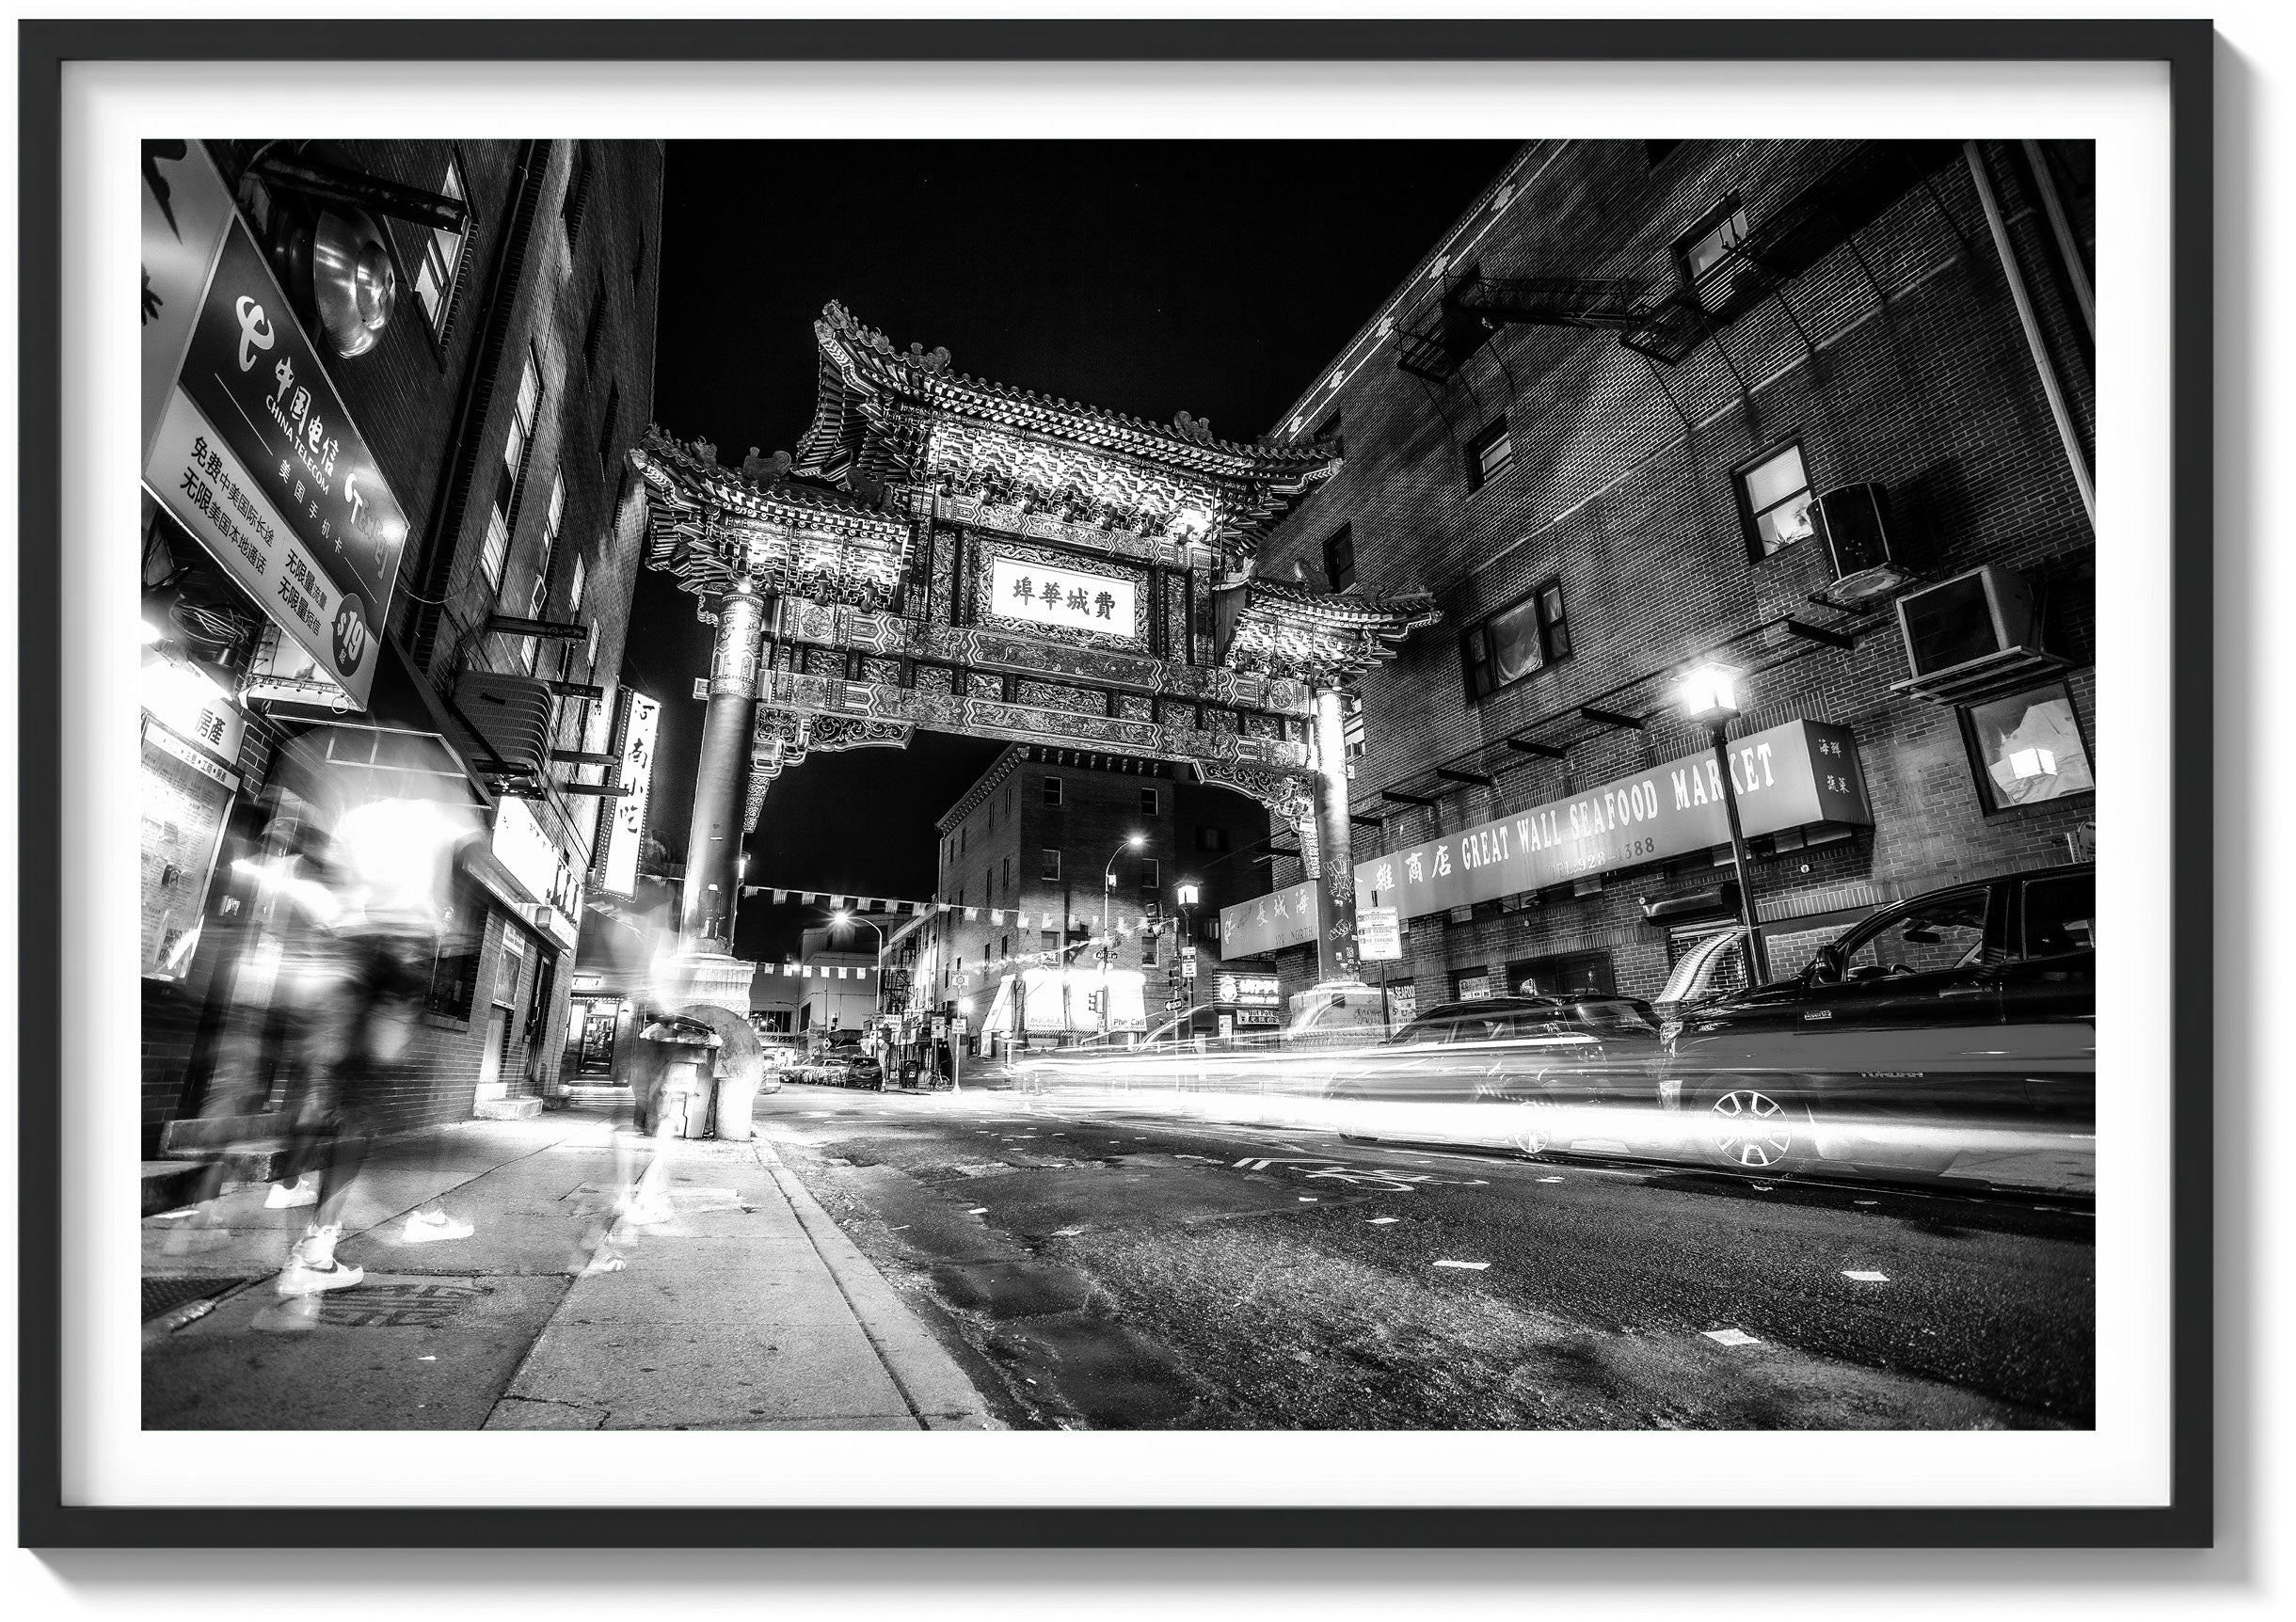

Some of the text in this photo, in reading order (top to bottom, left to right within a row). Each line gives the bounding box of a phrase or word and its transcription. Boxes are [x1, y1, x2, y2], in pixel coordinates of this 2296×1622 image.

[265, 394, 329, 496] CHINA TELECOM
[275, 357, 339, 478] 中国电信
[180, 466, 267, 576] 无限美国本地通话
[191, 436, 275, 548] 免费中美国际长途
[279, 459, 343, 554] 美国手机卡
[277, 575, 322, 637] 无限量短信
[284, 548, 327, 612] 无限量流量
[337, 611, 364, 661] $19
[1461, 741, 1775, 870] GREAT WALL SEAFOOD MARKET
[1355, 845, 1452, 896] 雜商店
